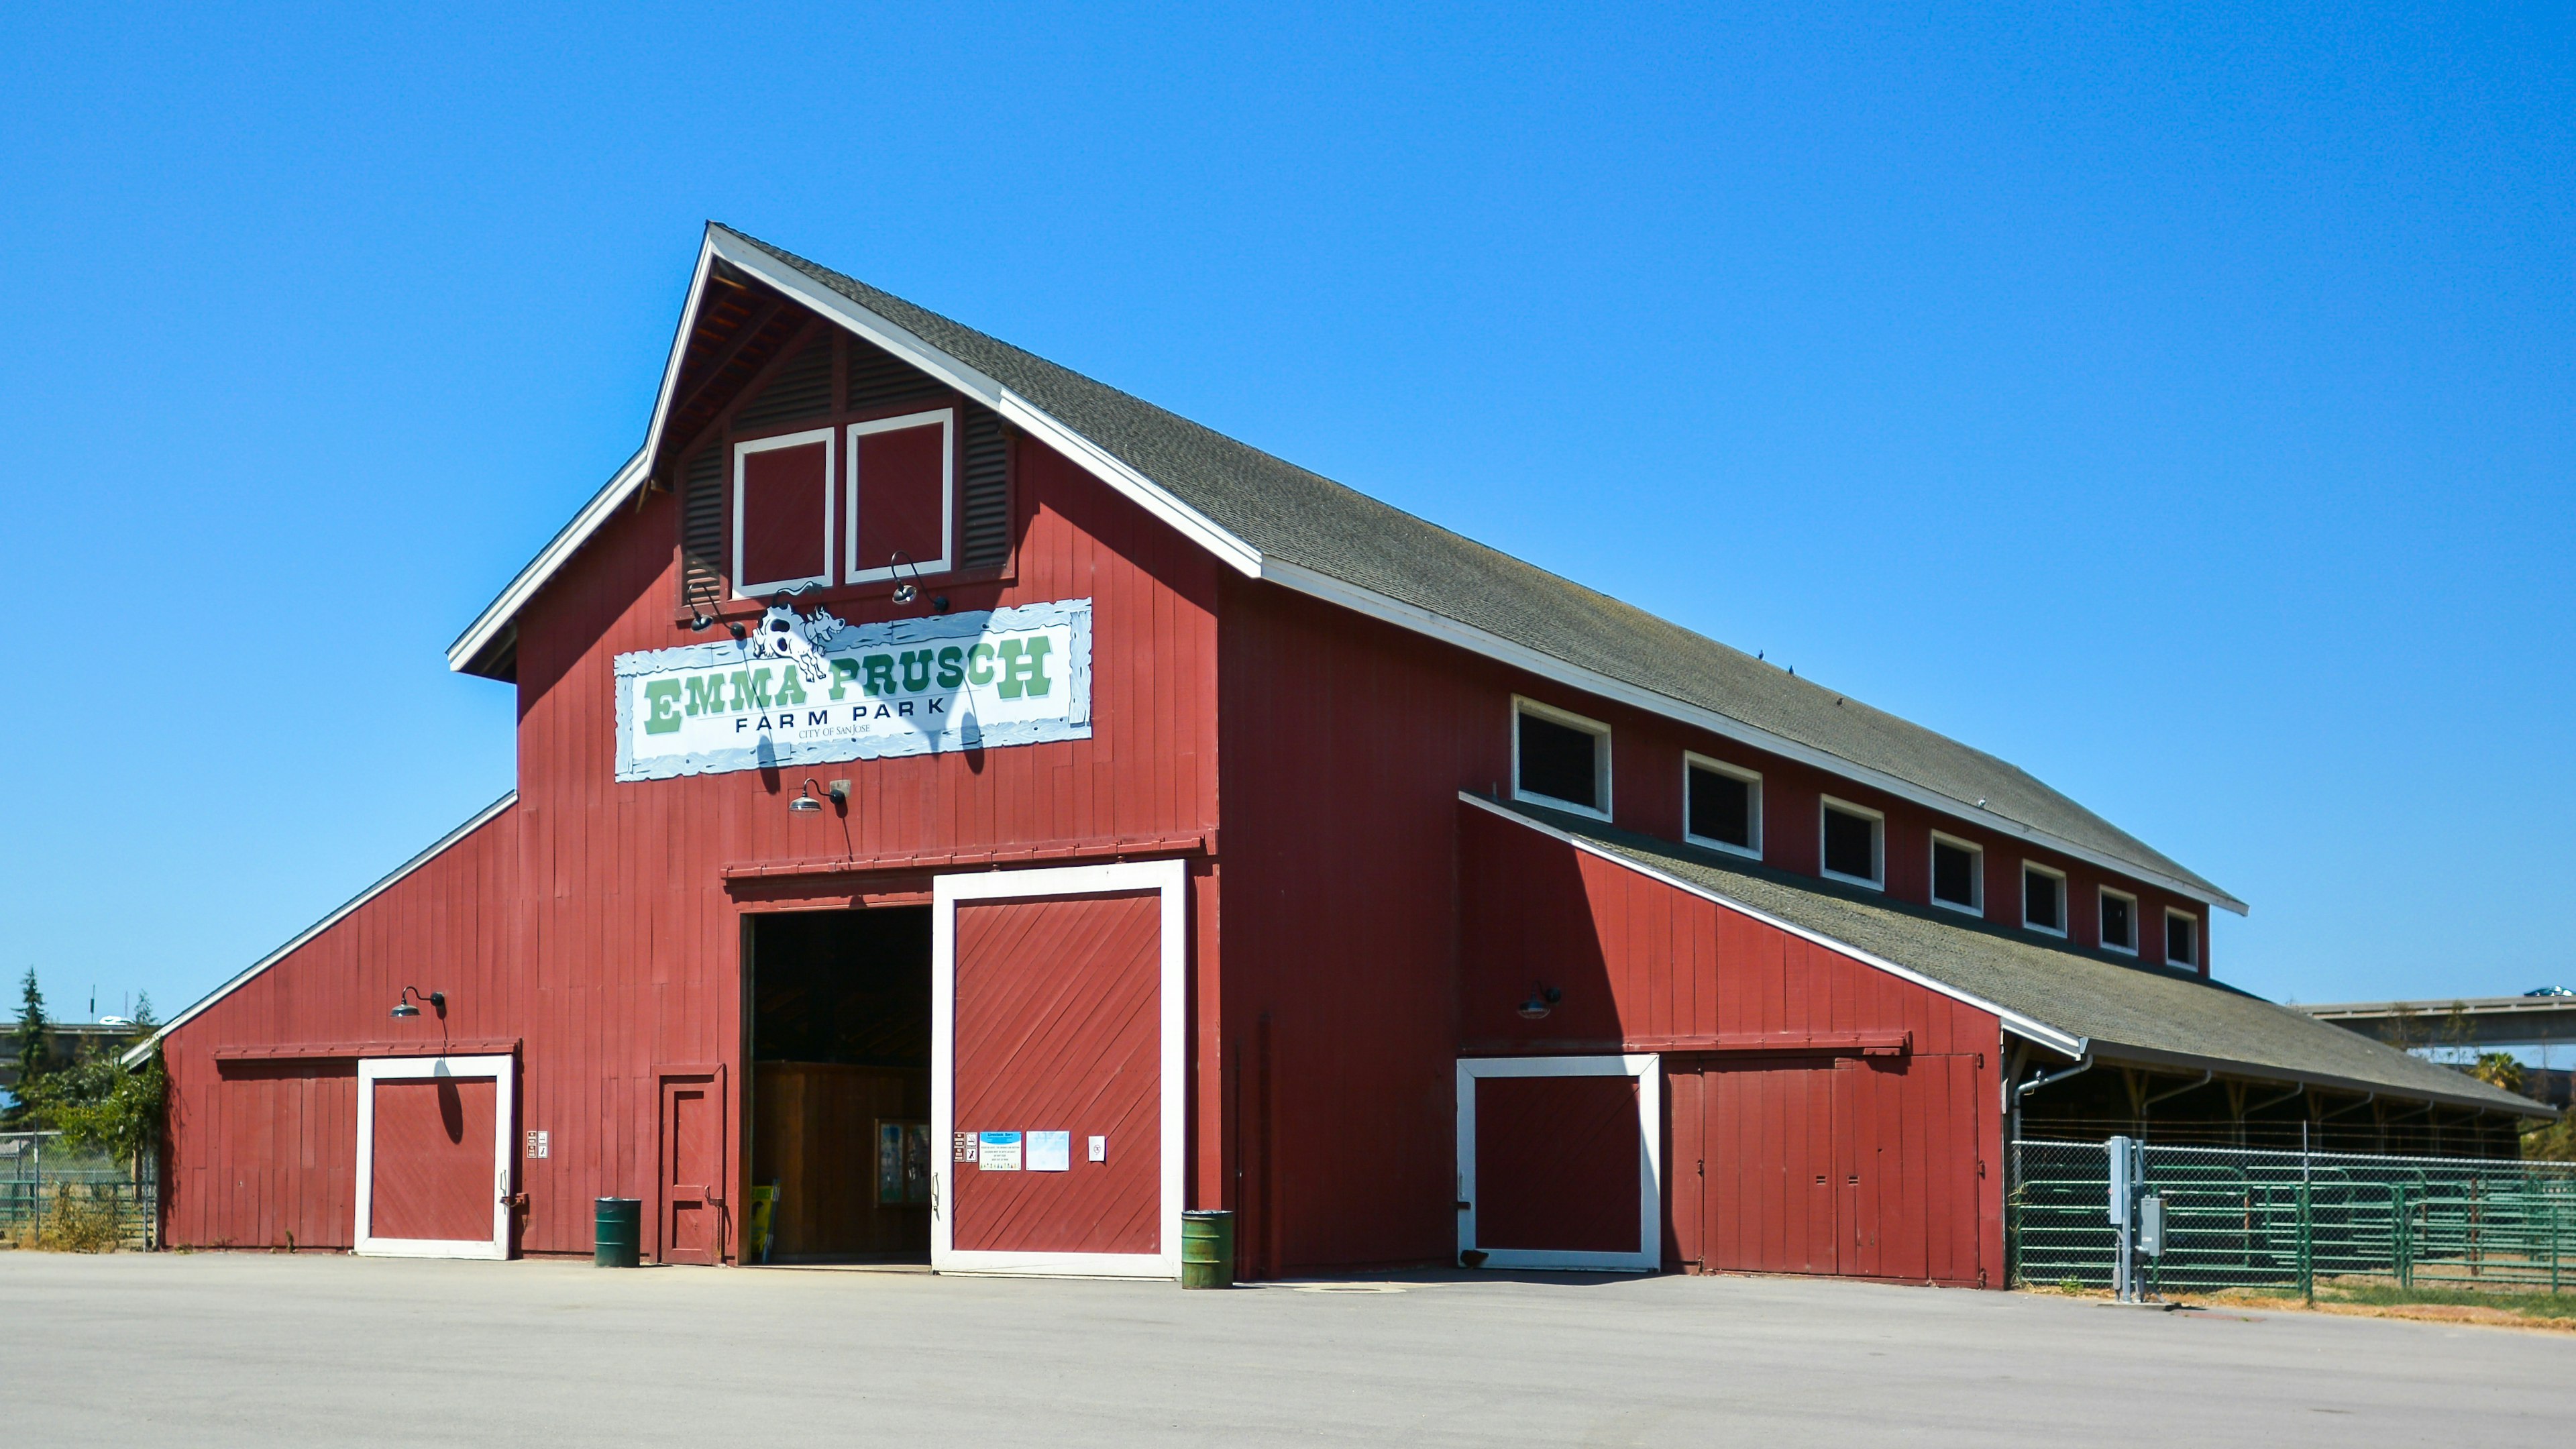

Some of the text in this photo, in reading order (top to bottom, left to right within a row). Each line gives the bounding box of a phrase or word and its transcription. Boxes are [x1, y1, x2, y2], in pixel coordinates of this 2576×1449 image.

[643, 635, 1053, 735] EMMA PRUSCH
[735, 697, 947, 733] FARM PARK
[799, 729, 820, 739] CITY
[822, 727, 834, 737] OF
